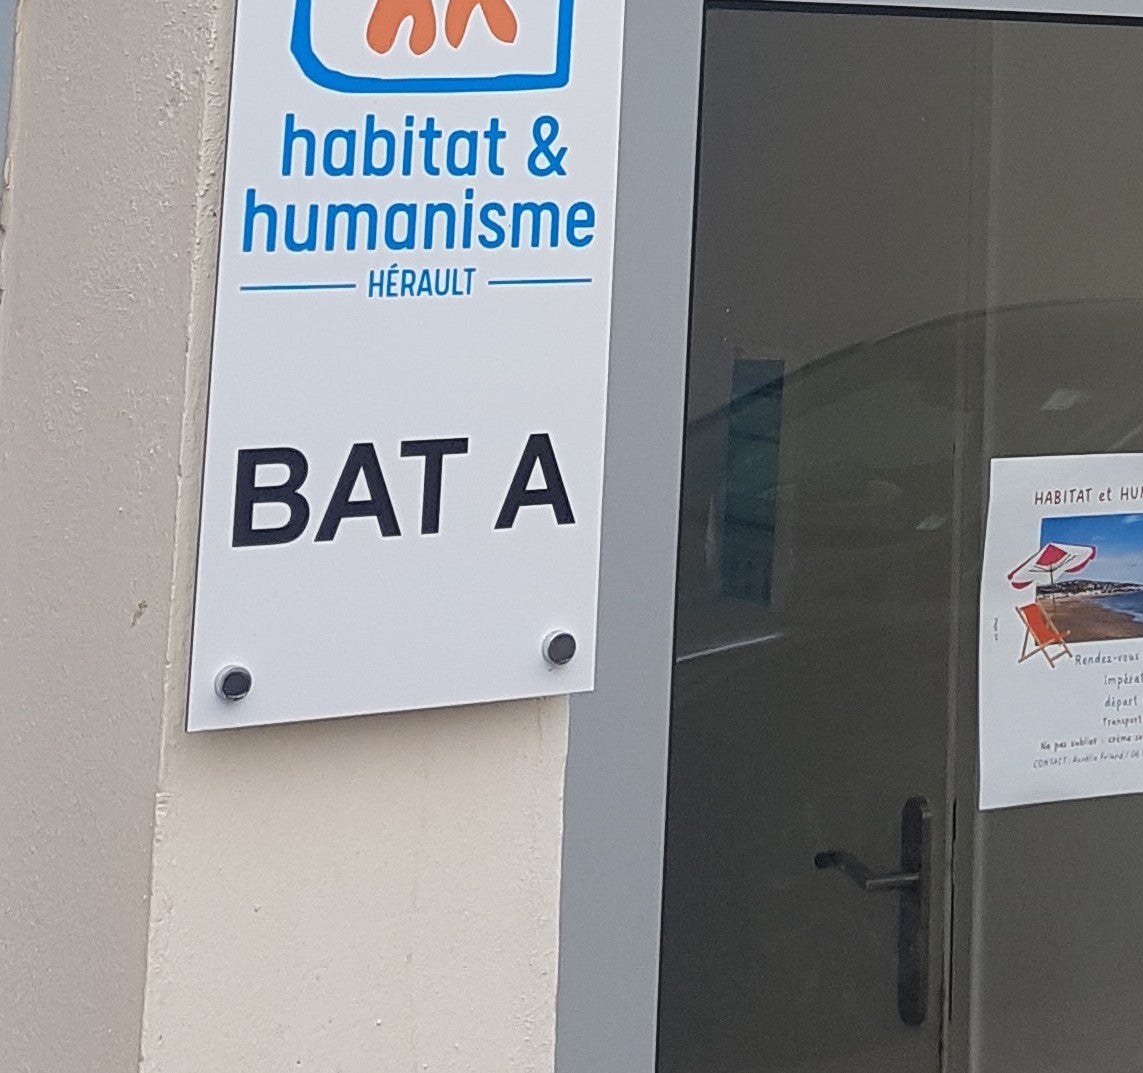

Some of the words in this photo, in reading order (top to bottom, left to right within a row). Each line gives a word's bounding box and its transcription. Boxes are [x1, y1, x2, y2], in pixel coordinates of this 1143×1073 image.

[281, 113, 507, 177] habitat
[527, 115, 568, 177] &
[242, 188, 596, 253] humanisme
[368, 263, 477, 298] HÉRAULT
[232, 437, 469, 548] BAT
[494, 433, 576, 530] A
[1034, 488, 1093, 506] HABITAT
[1099, 489, 1112, 503] et
[1074, 650, 1140, 666] Rendez-vous
[1104, 694, 1138, 711] départ
[1102, 712, 1142, 728] Transport
